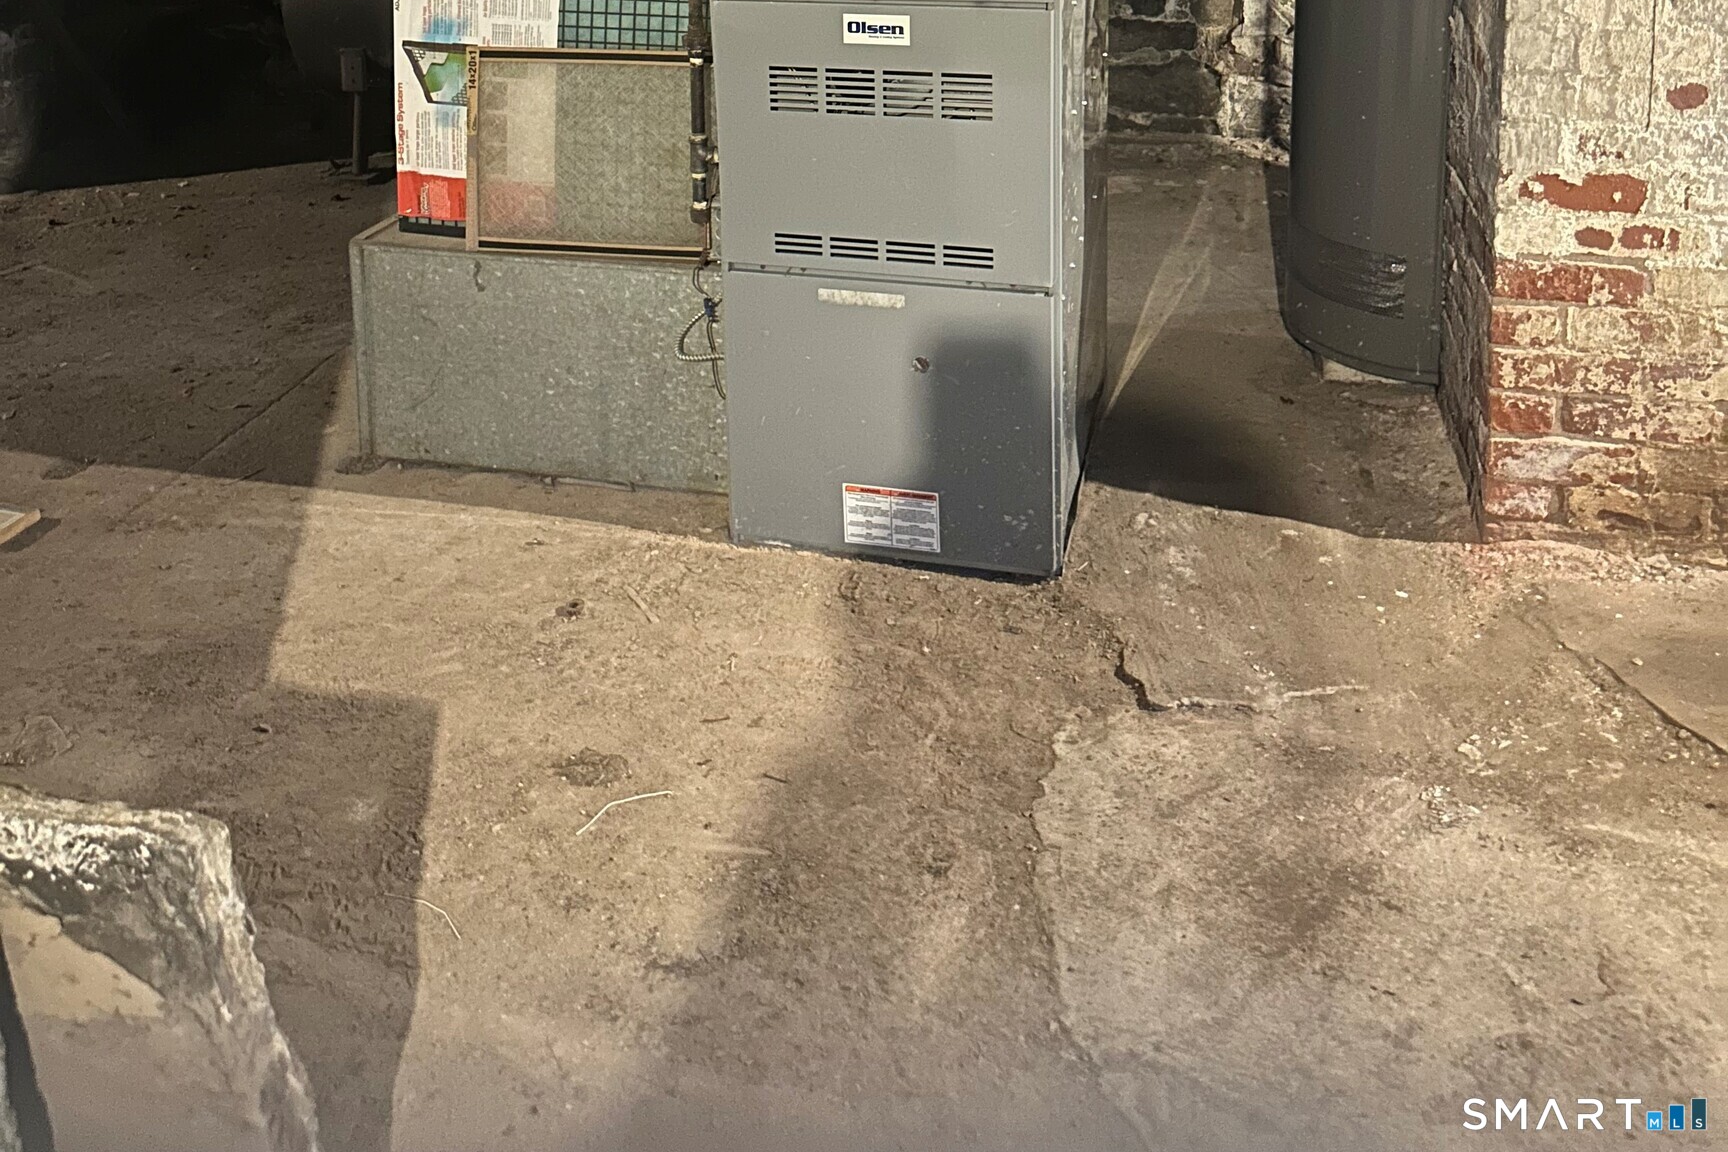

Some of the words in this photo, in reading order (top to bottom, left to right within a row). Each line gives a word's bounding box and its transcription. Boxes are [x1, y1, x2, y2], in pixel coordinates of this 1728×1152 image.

[847, 21, 904, 35] Olsen
[396, 82, 405, 122] System
[397, 123, 406, 165] 3-Stage
